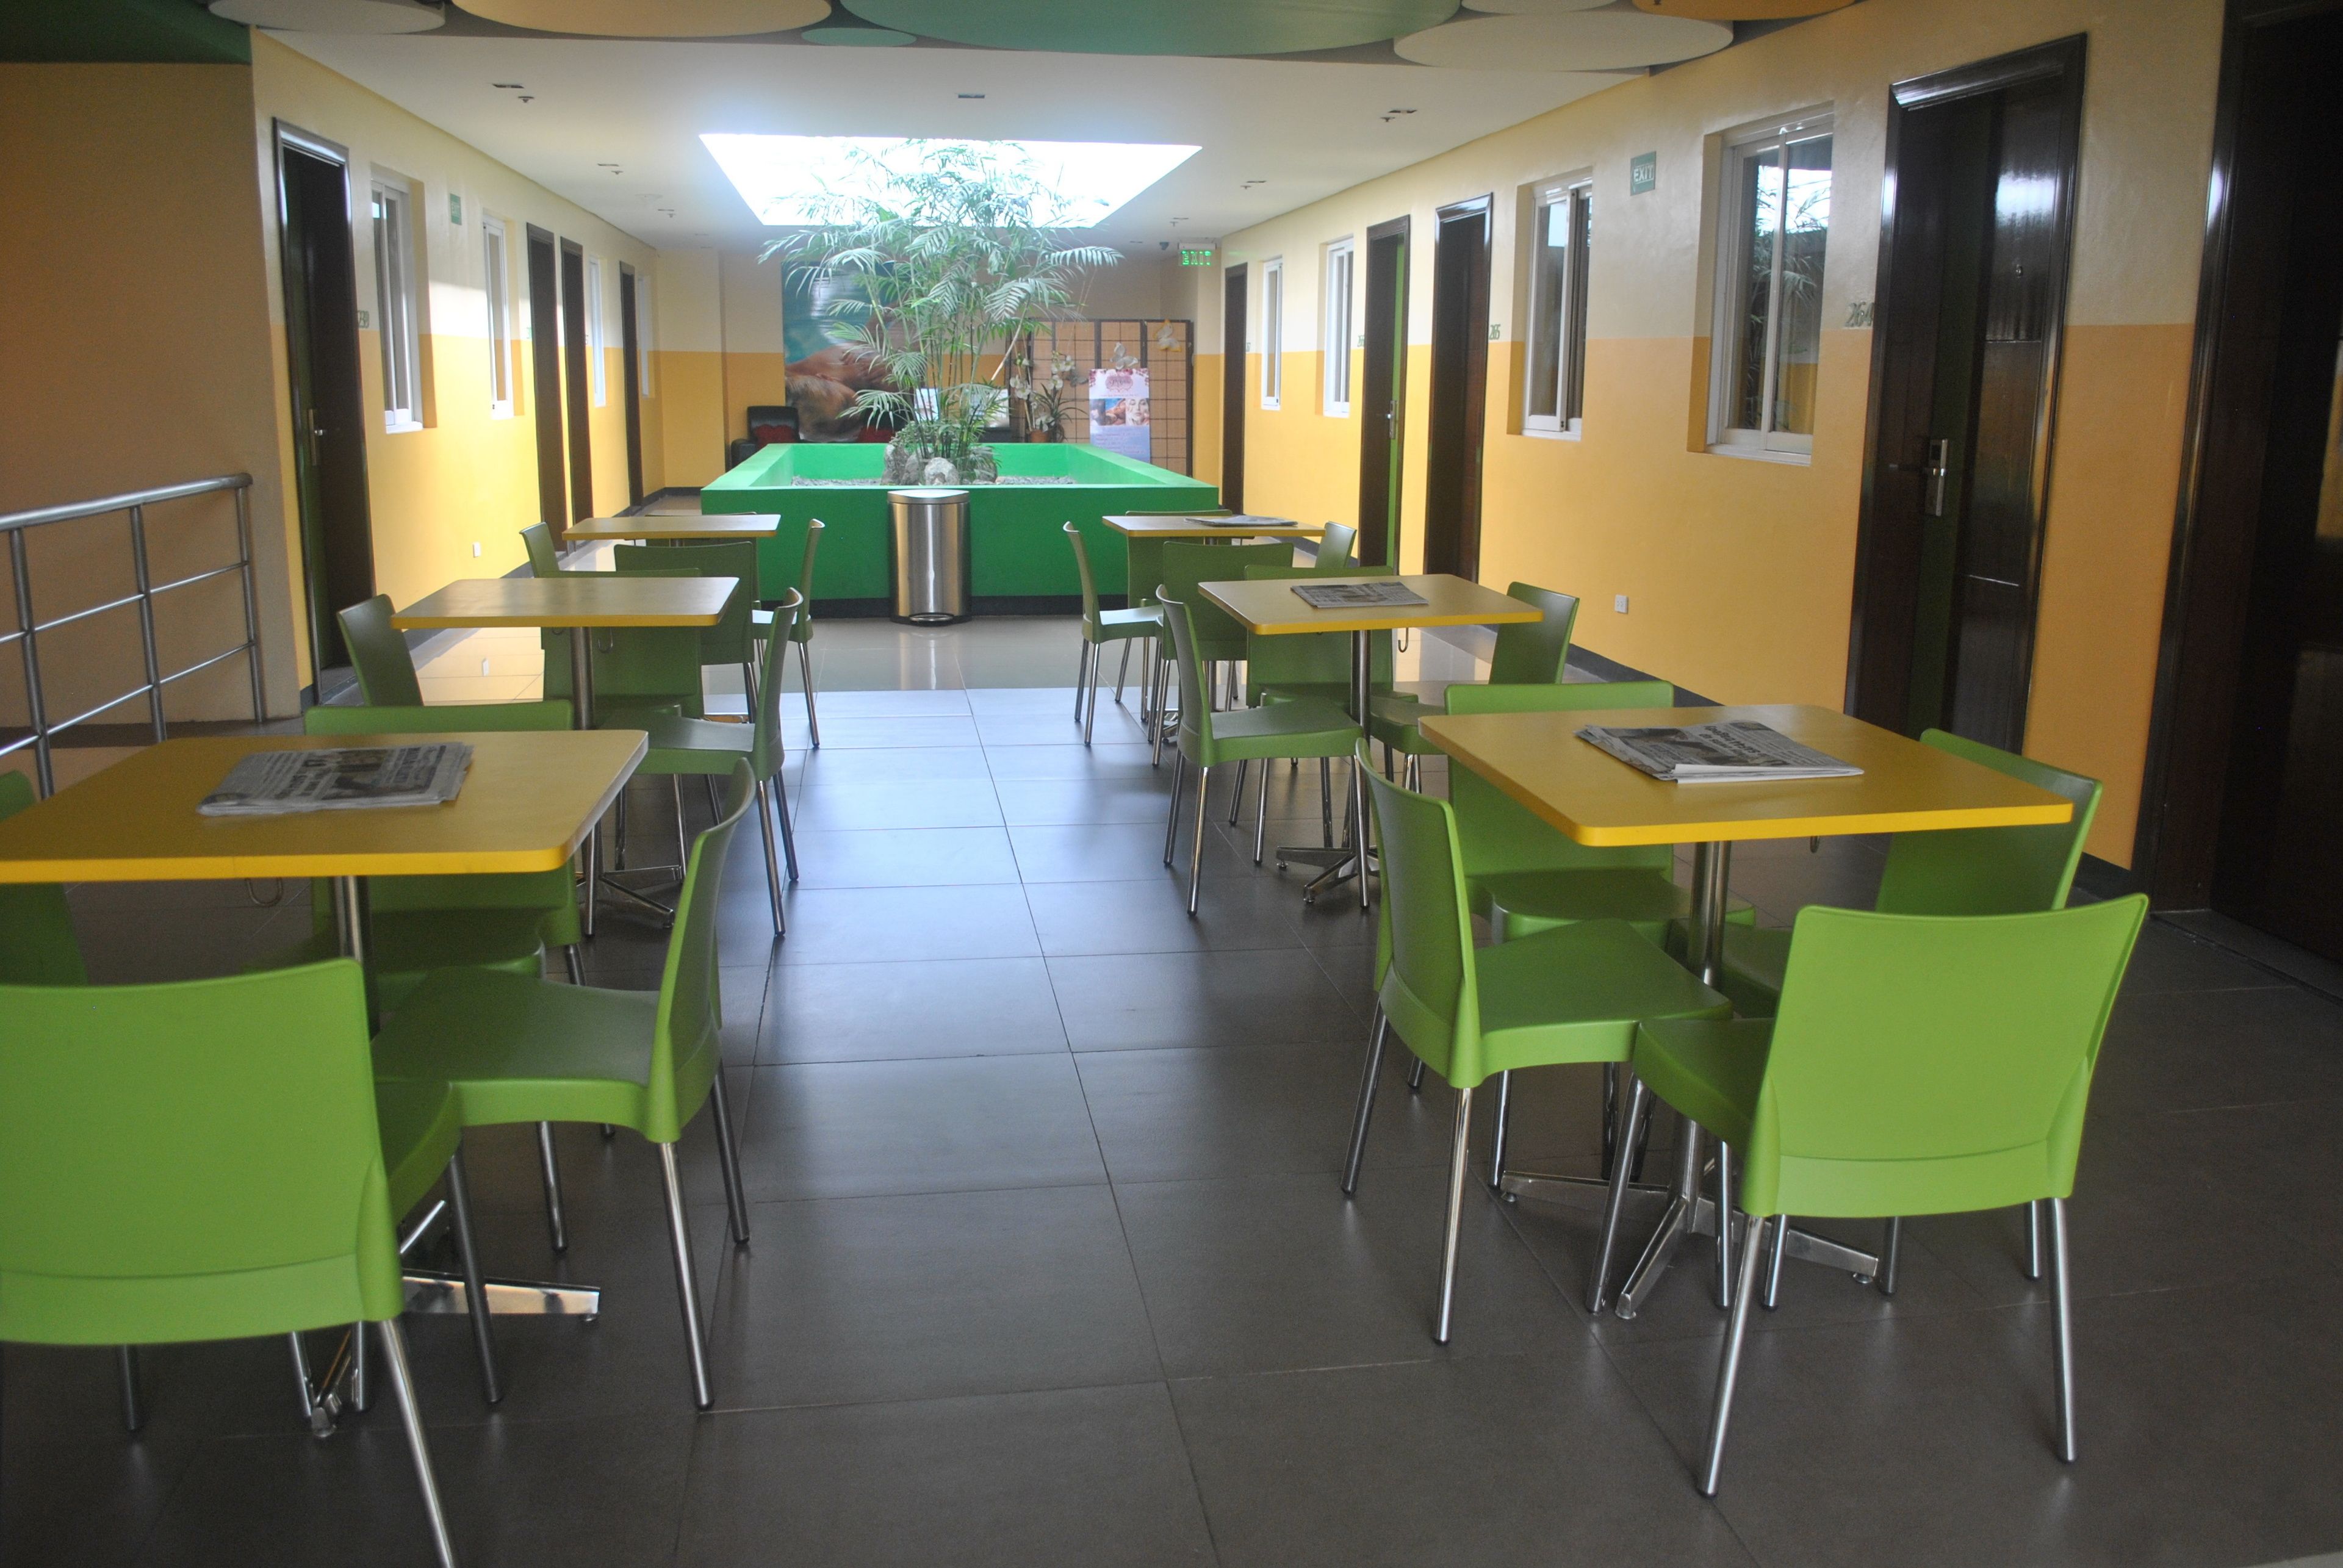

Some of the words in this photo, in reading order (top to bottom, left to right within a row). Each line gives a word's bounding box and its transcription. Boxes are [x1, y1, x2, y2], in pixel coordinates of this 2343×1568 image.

[1634, 165, 1654, 182] EXIT
[1182, 250, 1211, 265] EXIT
[1845, 301, 1874, 328] 264
